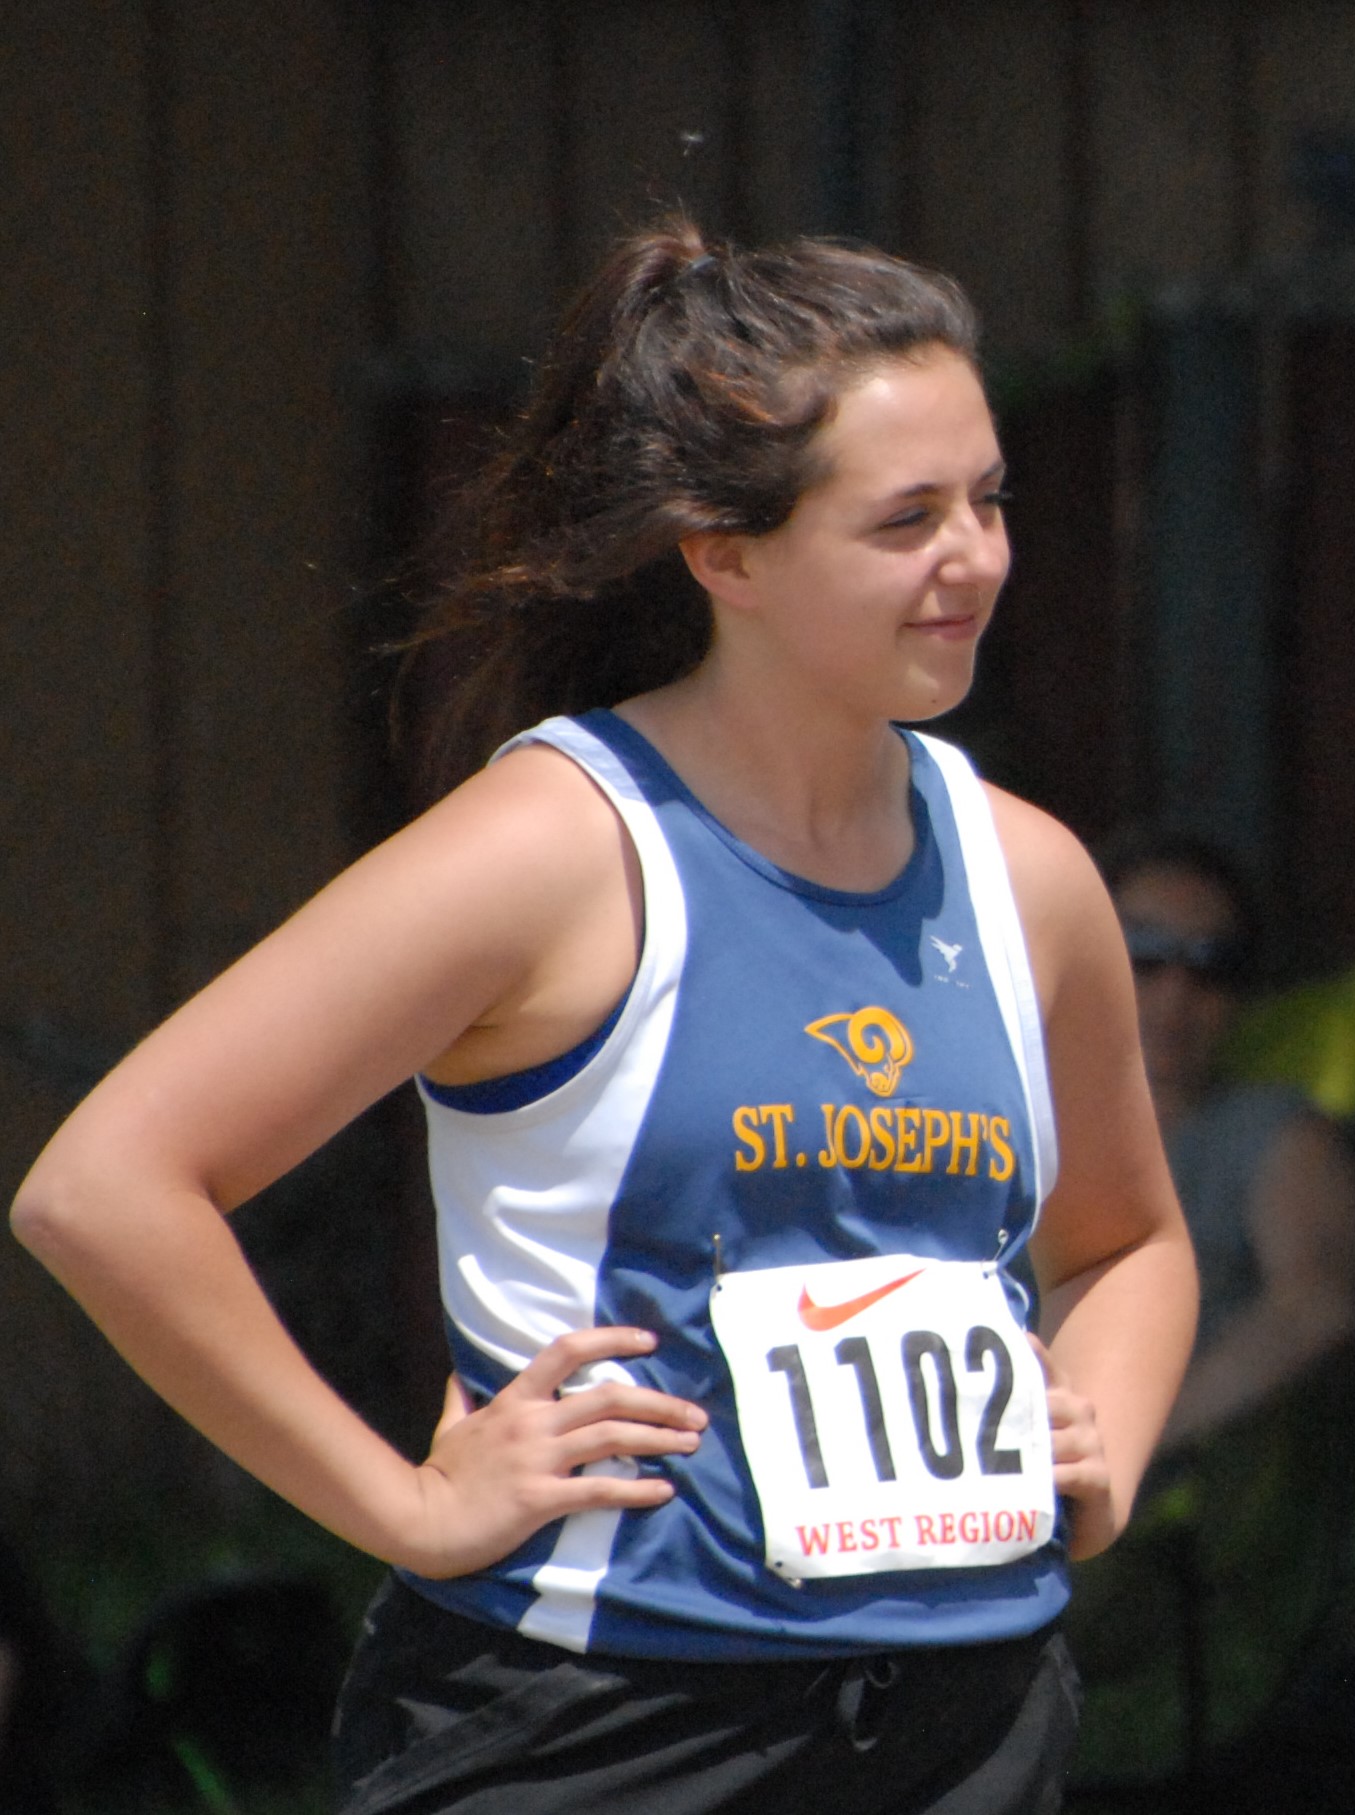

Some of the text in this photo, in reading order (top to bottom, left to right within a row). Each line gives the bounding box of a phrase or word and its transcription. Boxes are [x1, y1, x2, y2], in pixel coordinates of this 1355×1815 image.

[731, 1104, 1016, 1182] ST. JOSEPH'S
[765, 1325, 1023, 1489] 1102
[796, 1509, 1040, 1557] WEST REGION
